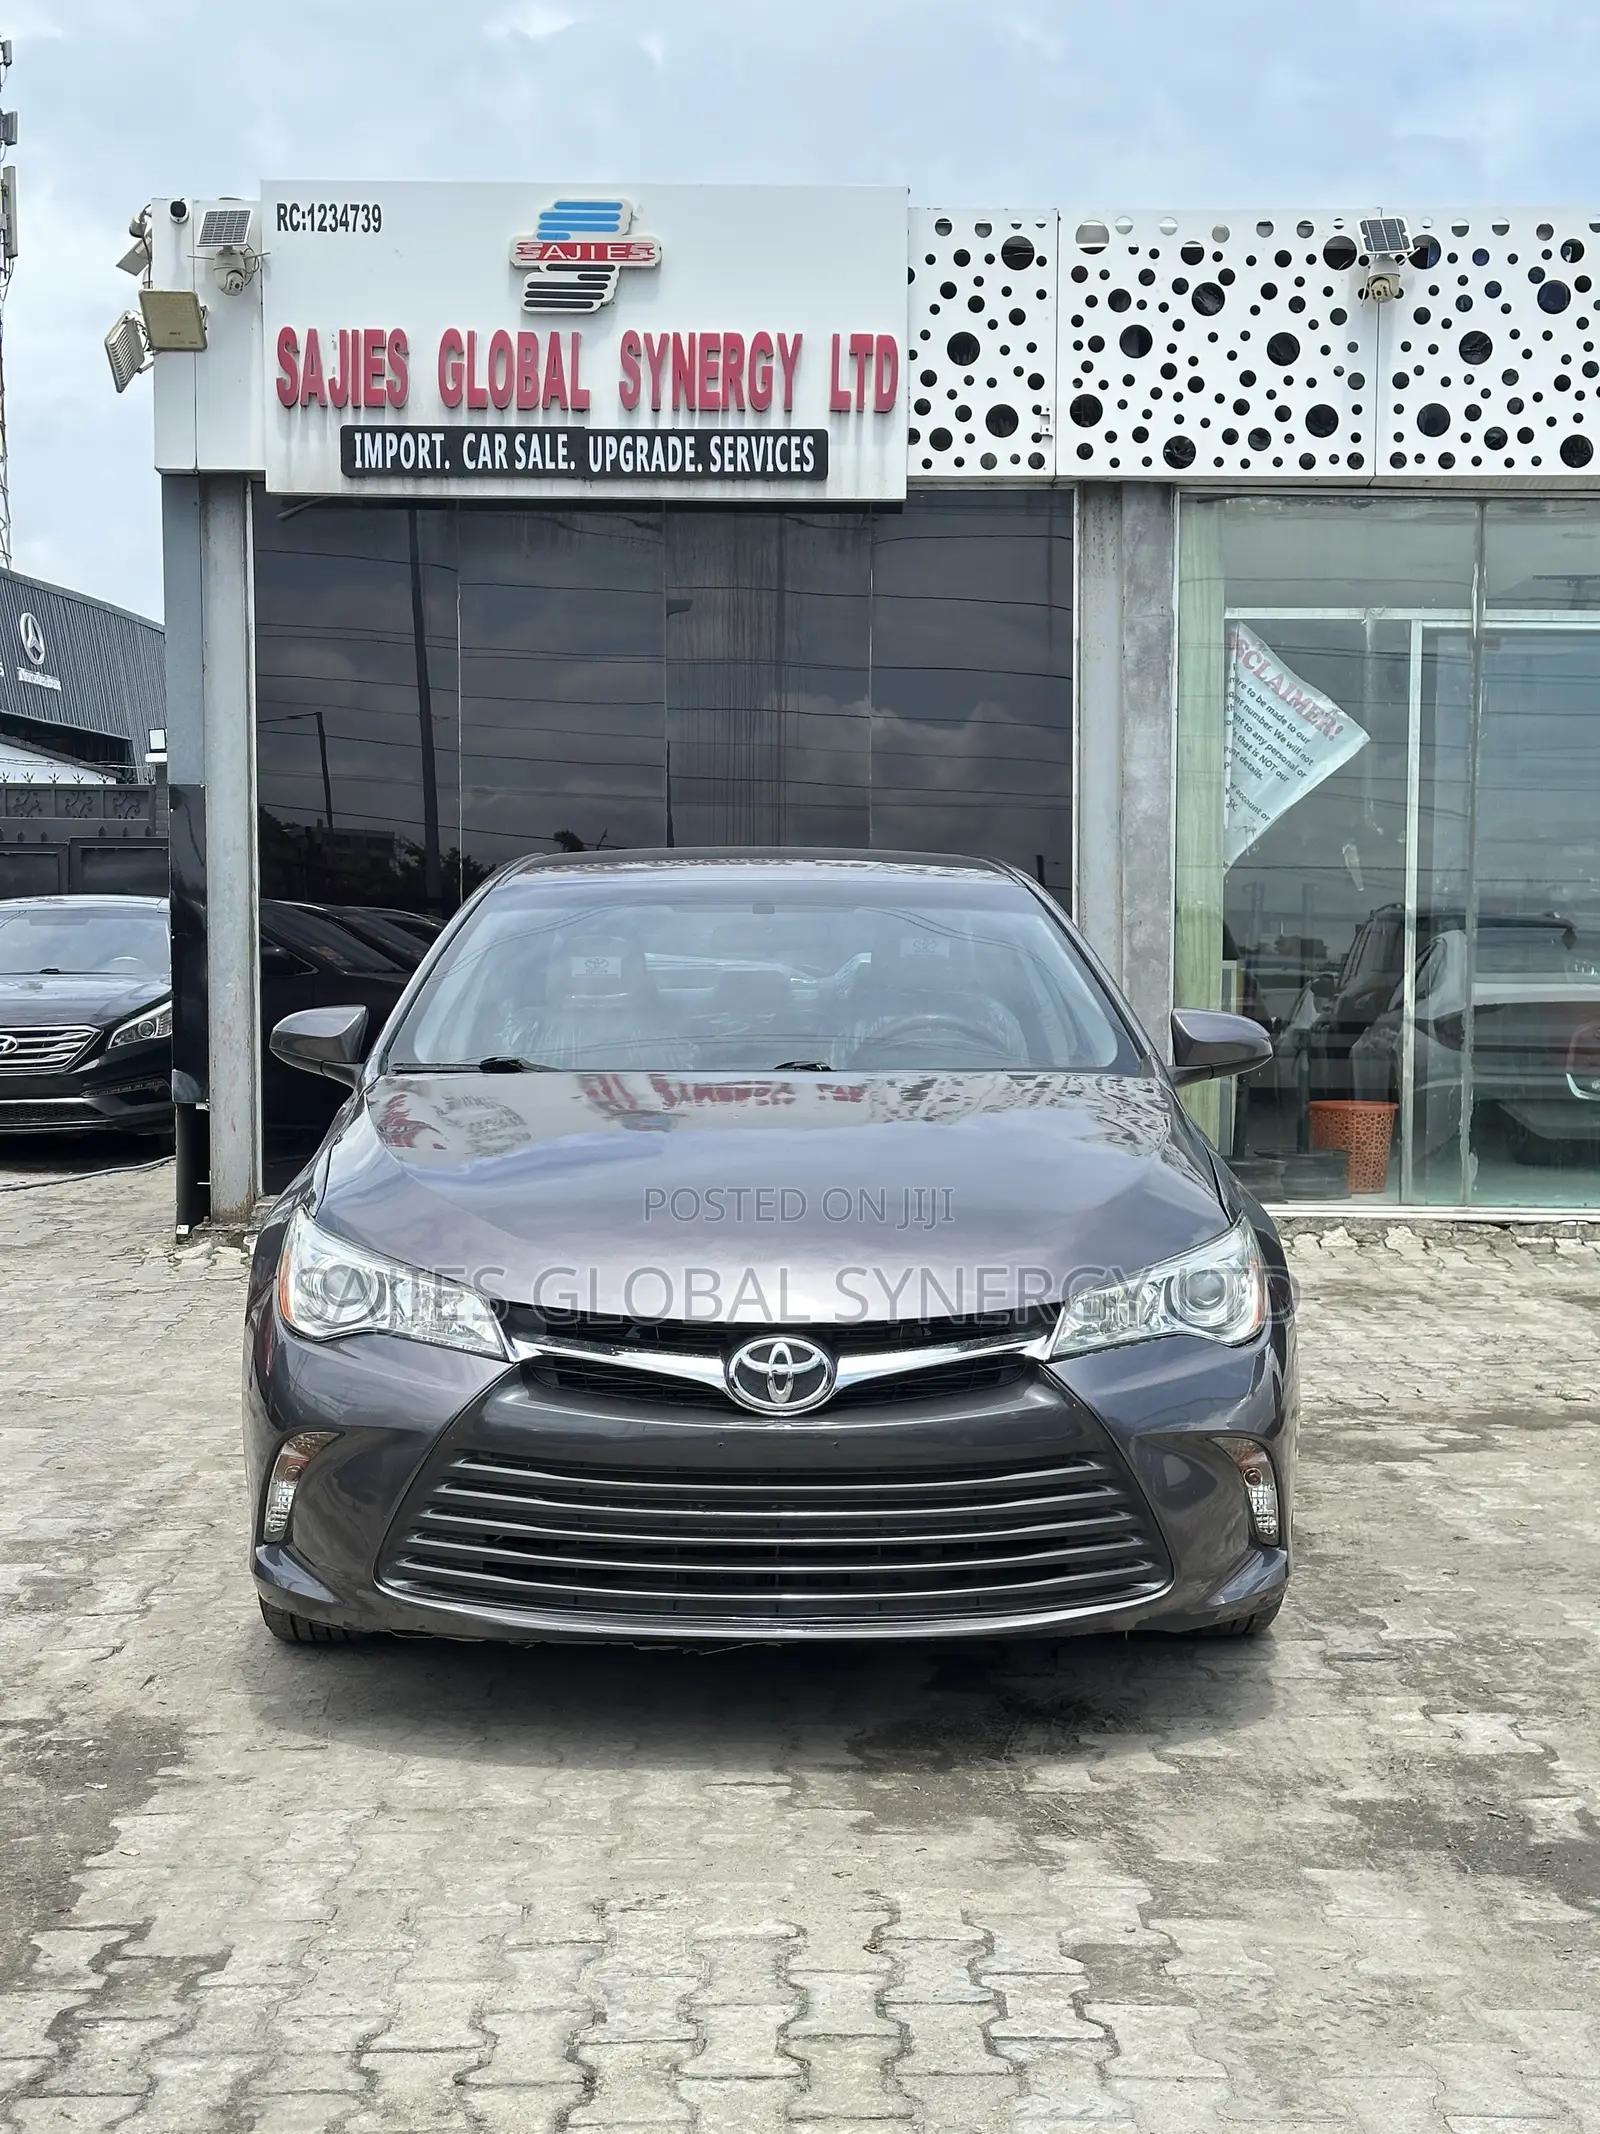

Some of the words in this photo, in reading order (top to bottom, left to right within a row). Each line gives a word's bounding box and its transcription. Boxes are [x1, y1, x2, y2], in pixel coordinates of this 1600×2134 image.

[275, 203, 383, 233] RC:1234739
[515, 242, 656, 260] SAJIES
[275, 326, 410, 409] SAJIES
[437, 327, 591, 411] GLOBAL
[618, 329, 804, 412] SYNERGY
[829, 333, 899, 413] LTD
[354, 431, 450, 470] IMPORT.
[462, 432, 508, 470] CAR
[514, 432, 576, 470] SALE.
[588, 434, 703, 473] UPGRADE.
[709, 434, 815, 473] SERVICES
[1243, 703, 1274, 733] number.
[1273, 729, 1287, 743] We
[1286, 741, 1302, 755] will
[1299, 753, 1314, 767] not
[1246, 687, 1256, 698] to
[1255, 694, 1267, 707] be
[1265, 705, 1288, 725] made
[1286, 722, 1297, 733] to
[1296, 731, 1311, 745] our
[1237, 734, 1253, 752] that
[1251, 747, 1260, 758] is
[1258, 754, 1278, 773] NOT
[1275, 770, 1290, 783] our
[1239, 755, 1264, 781] details.
[1243, 722, 1253, 733] to
[1252, 731, 1268, 746] any
[1264, 743, 1300, 771] personal
[1296, 769, 1308, 779] or
[1235, 788, 1263, 816] account
[1260, 812, 1271, 822] or
